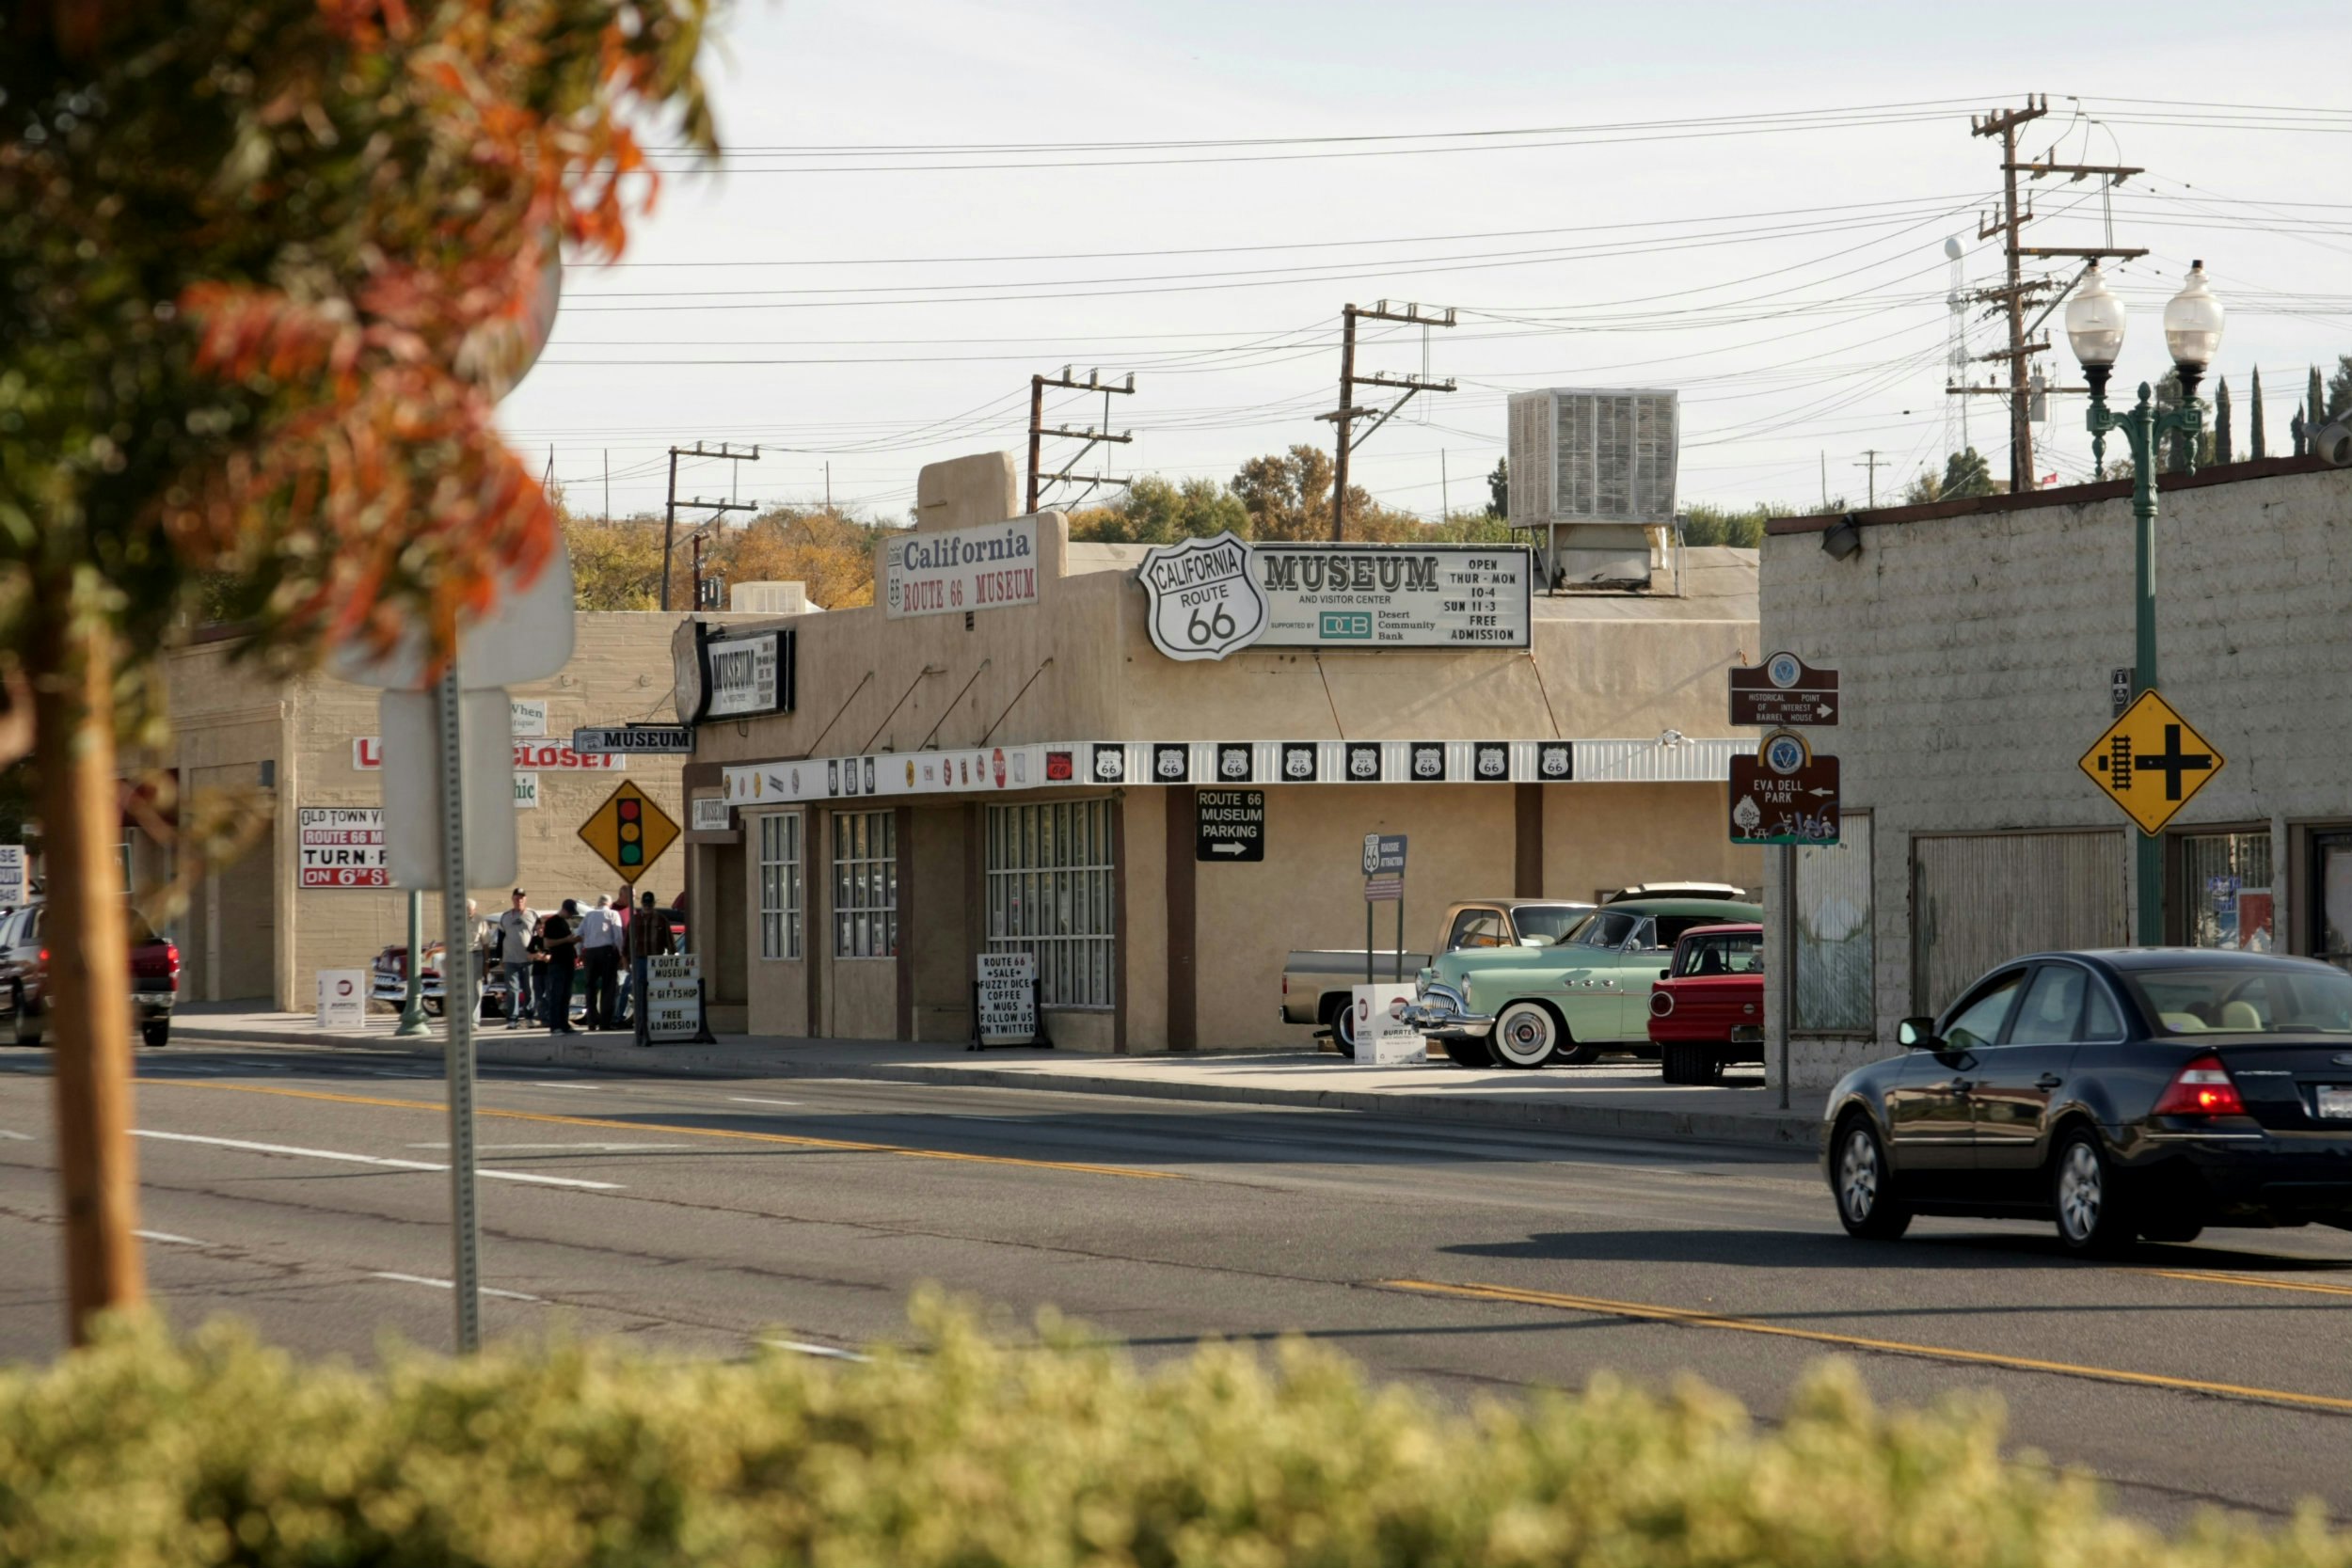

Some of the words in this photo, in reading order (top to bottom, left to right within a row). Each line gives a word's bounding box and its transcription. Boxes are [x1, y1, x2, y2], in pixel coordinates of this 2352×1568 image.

[904, 529, 1030, 570] California
[1156, 547, 1239, 590] CALIFORNIA
[1469, 560, 1497, 570] OPEN
[1263, 555, 1438, 593] MUSEUM
[1450, 574, 1479, 583] THUR
[1492, 574, 1516, 584] MON
[890, 578, 899, 600] 66
[903, 579, 944, 611] ROUTE
[950, 579, 962, 607] 66
[976, 568, 1035, 604] MUSEUM
[1471, 588, 1495, 597] 10-4
[1181, 584, 1229, 608] ROUTE
[1299, 595, 1316, 604] AND
[1321, 595, 1353, 604] VISITOR
[1356, 595, 1391, 604] CENTER
[1444, 601, 1465, 611] SUN
[1187, 602, 1235, 645] 66
[1323, 615, 1368, 634] DCB
[1470, 615, 1497, 626] FREE
[1378, 621, 1436, 631] Community
[1378, 632, 1404, 641] Bank
[1451, 629, 1514, 640] ADMISSION
[713, 649, 755, 692] MUSEUM
[1748, 693, 1785, 702] HISTORICAL
[1801, 693, 1820, 702] POINT
[1757, 703, 1767, 711] OF
[1780, 704, 1811, 712] INTEREST
[1756, 713, 1784, 721] BARREL
[1790, 713, 1813, 721] HOUSE
[604, 732, 690, 747] MUSEUM
[1053, 765, 1066, 775] 66
[1102, 765, 1116, 773] 66
[1163, 765, 1178, 773] 66
[1227, 764, 1242, 773] 66
[1292, 764, 1306, 773] 66
[1356, 764, 1371, 772] 66
[1421, 764, 1435, 772] 66
[1484, 763, 1499, 772] 66
[1548, 763, 1562, 771] 66
[1754, 780, 1773, 791] EVA
[1777, 780, 1803, 791] DELL
[1199, 793, 1241, 805] ROUTE
[1248, 793, 1262, 805] 66
[1765, 792, 1792, 803] PARK
[701, 800, 728, 821] MUSEUM
[1201, 809, 1263, 821] MUSEUM
[302, 811, 326, 826] OLD
[329, 811, 366, 826] TOWN
[1202, 825, 1257, 838] PARKING
[305, 831, 346, 844] ROUTE
[350, 831, 367, 844] 66
[303, 850, 365, 864] TURN
[1366, 846, 1377, 868] 66
[1380, 857, 1404, 867] ATTRACTION
[305, 870, 331, 883] ON
[651, 958, 679, 967] ROUTE
[685, 958, 695, 967] 66
[984, 958, 1011, 967] ROUTE
[1014, 958, 1025, 966] 66
[655, 968, 691, 977] MUSEUM
[993, 969, 1015, 977] SALE
[979, 980, 1008, 990] FUZZY
[1010, 979, 1030, 989] DICE
[987, 990, 1021, 1000] COFFEE
[993, 1002, 1018, 1011] MUGS
[661, 1010, 682, 1020] FREE
[980, 1013, 1018, 1022] FOLLOW
[1021, 1013, 1033, 1022] US
[650, 1021, 697, 1031] ADMISSION
[979, 1025, 991, 1034] ON
[995, 1023, 1035, 1034] TWITTER
